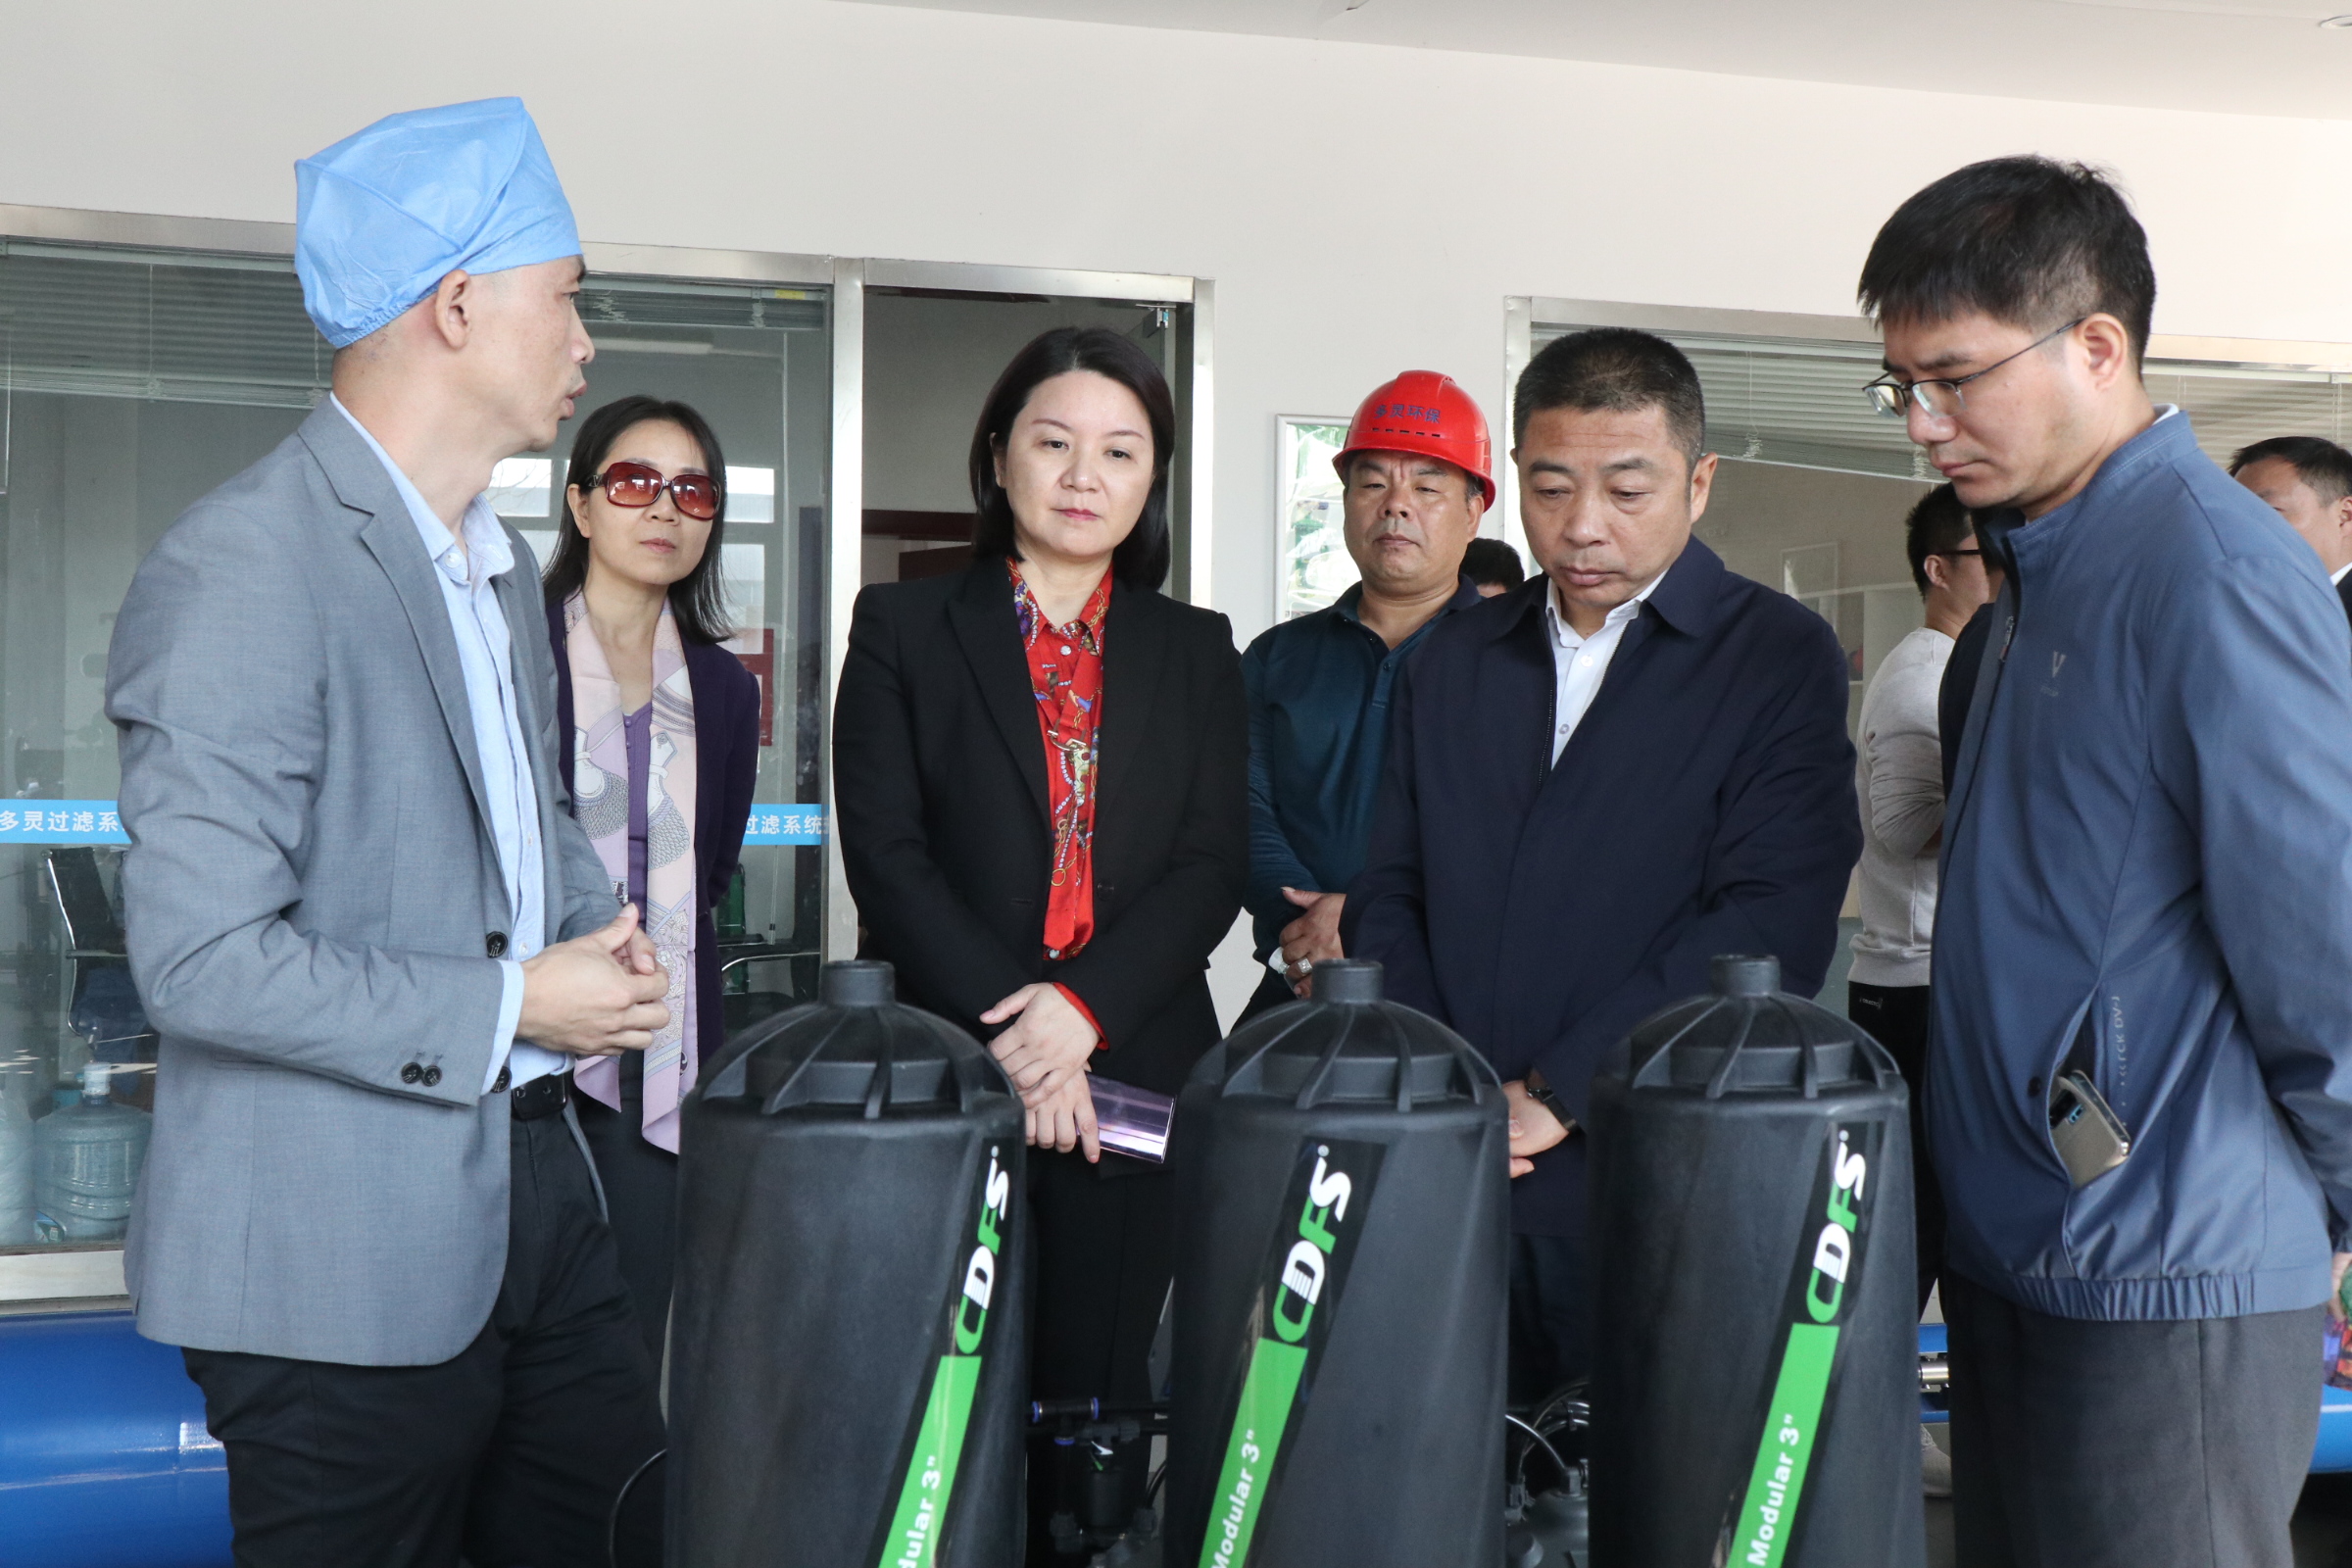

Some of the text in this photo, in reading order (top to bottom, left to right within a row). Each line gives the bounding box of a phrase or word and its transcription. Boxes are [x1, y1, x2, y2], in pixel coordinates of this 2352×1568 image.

[1373, 404, 1441, 423] 多灵环保
[0, 810, 126, 832] 多灵过滤系
[956, 1157, 1009, 1353] CDFS
[1272, 1156, 1352, 1343] CDFS
[1806, 1141, 1866, 1323] CDFS
[1746, 1451, 1794, 1566] Modular
